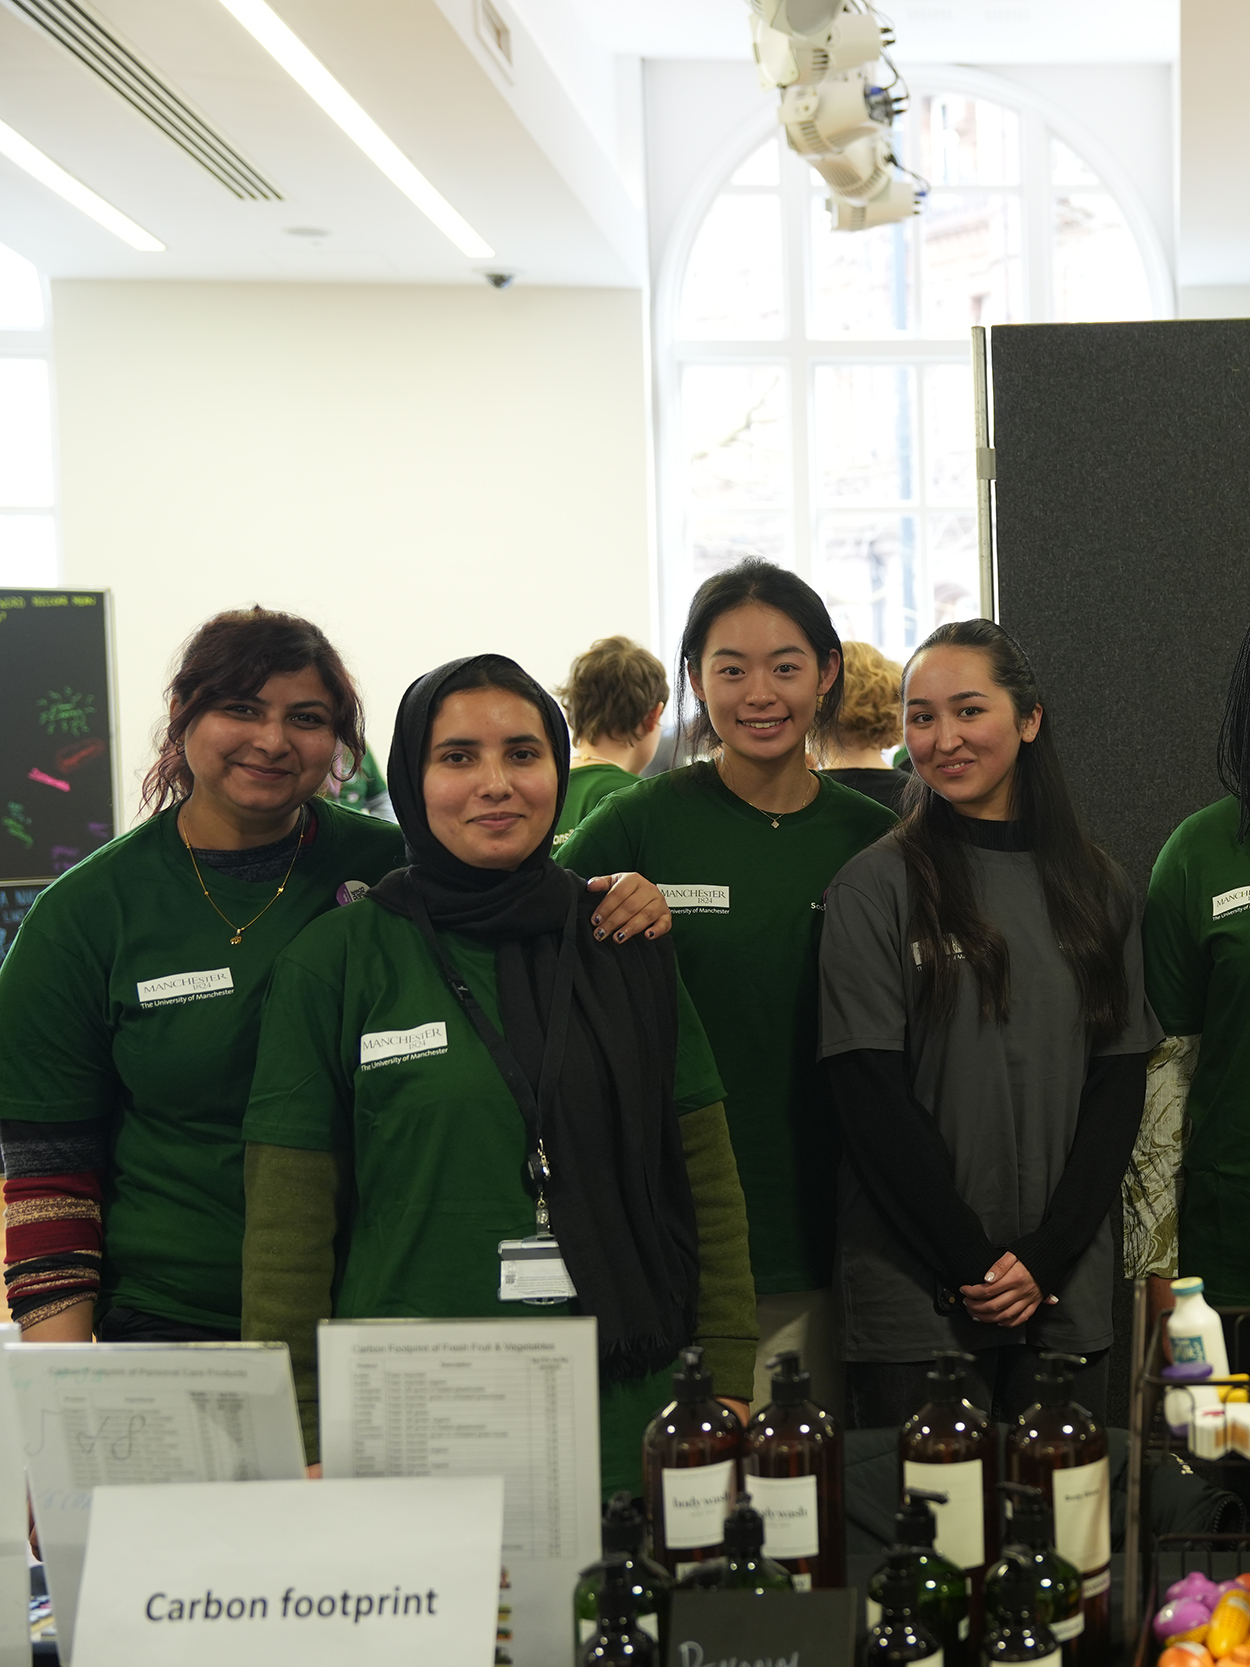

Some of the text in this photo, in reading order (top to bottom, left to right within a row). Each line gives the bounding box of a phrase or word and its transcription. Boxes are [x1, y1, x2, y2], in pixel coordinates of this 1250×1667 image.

[660, 888, 727, 899] MANCHESTER
[669, 908, 692, 916] niversity
[699, 907, 730, 915] Manchester
[1220, 907, 1243, 919] University
[143, 972, 229, 994] MANCHESTER
[192, 982, 212, 991] 1824
[140, 988, 235, 1010] The University of Manchester
[362, 1027, 443, 1051] MANCHESTER
[408, 1040, 426, 1050] 1824
[361, 1047, 449, 1073] The University of Manchester
[145, 1586, 438, 1625] Carbon footprint
